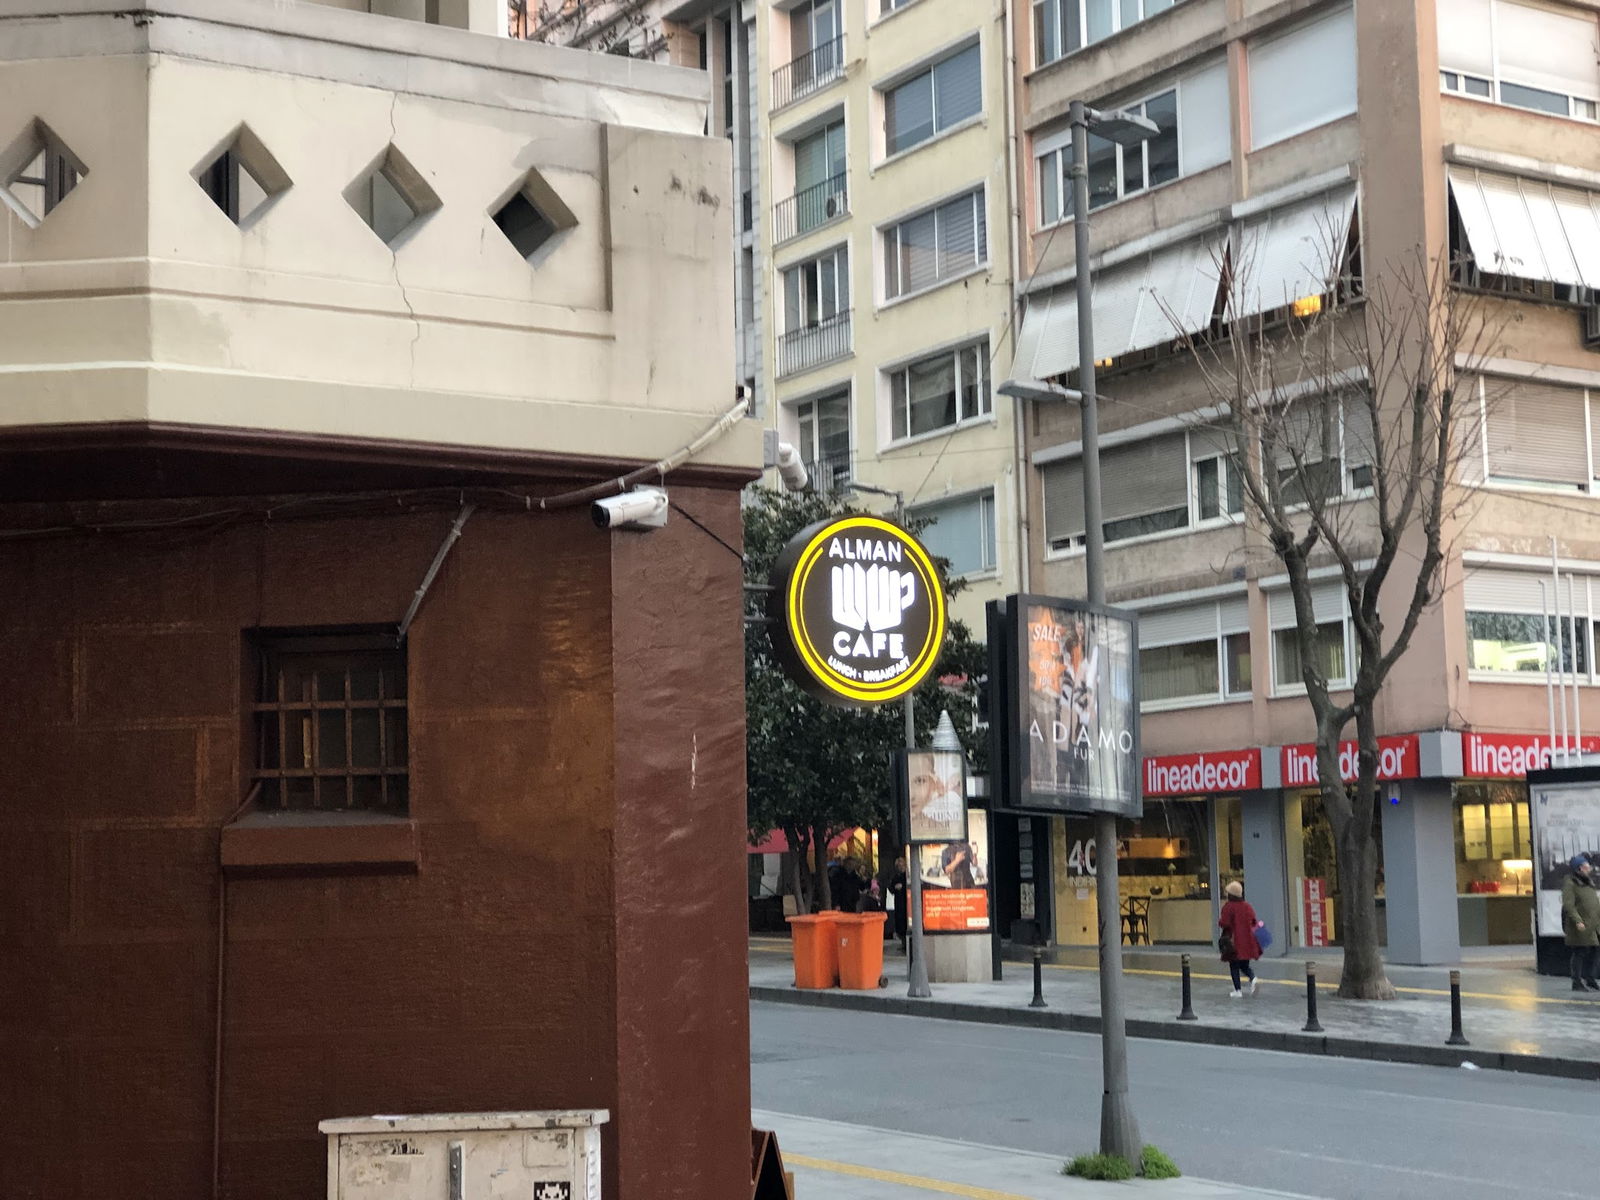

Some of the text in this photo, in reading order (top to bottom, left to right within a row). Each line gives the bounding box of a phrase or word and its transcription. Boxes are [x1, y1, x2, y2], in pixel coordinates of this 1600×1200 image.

[828, 537, 902, 562] ALMAN
[832, 631, 905, 659] CAFE
[1033, 624, 1061, 642] SALE
[827, 655, 857, 680] LUNCH
[1029, 719, 1133, 755] ADAMO
[1073, 745, 1095, 761] FUR
[1147, 755, 1250, 793] lineadecor
